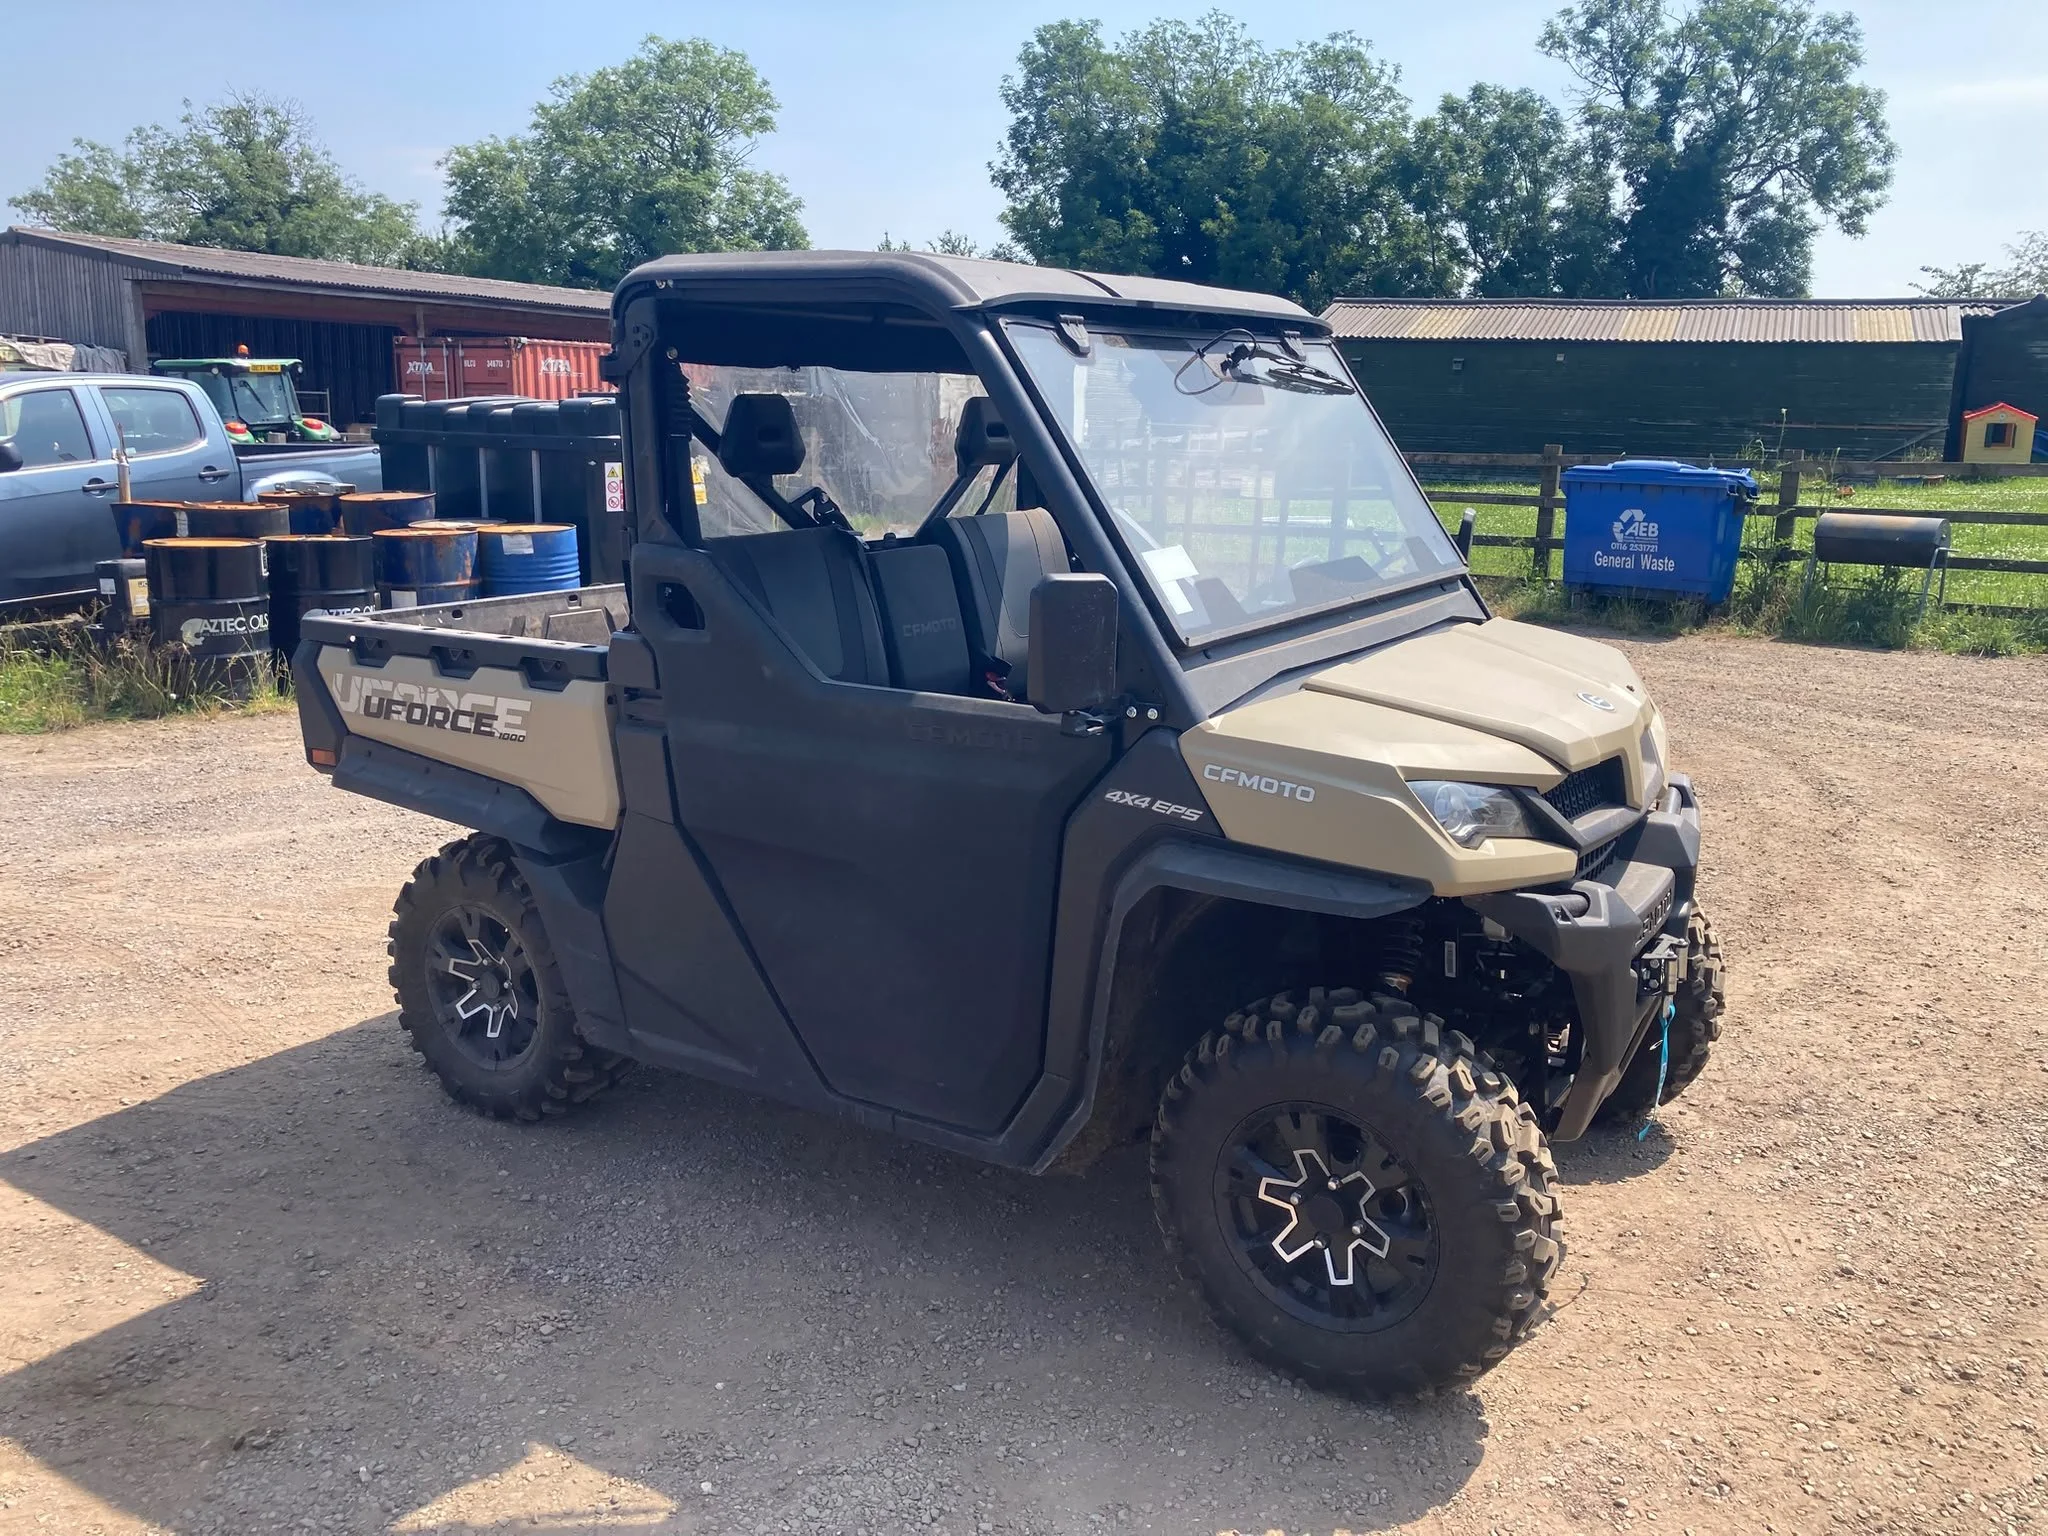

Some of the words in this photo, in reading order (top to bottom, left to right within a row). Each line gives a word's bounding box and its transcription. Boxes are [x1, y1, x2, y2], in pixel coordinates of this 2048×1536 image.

[1625, 522, 1659, 537] AEB
[1611, 542, 1628, 551] 0116
[1594, 551, 1635, 569] General
[1640, 554, 1675, 572] Waste
[200, 616, 247, 633] AZTEC
[249, 611, 269, 629] OILS
[902, 618, 956, 637] CFMOTO
[364, 695, 498, 737] UFORCE
[498, 732, 525, 743] 1000
[1203, 763, 1316, 803] CFMOTO
[1104, 790, 1151, 808] 4X4
[1151, 799, 1204, 821] EPS
